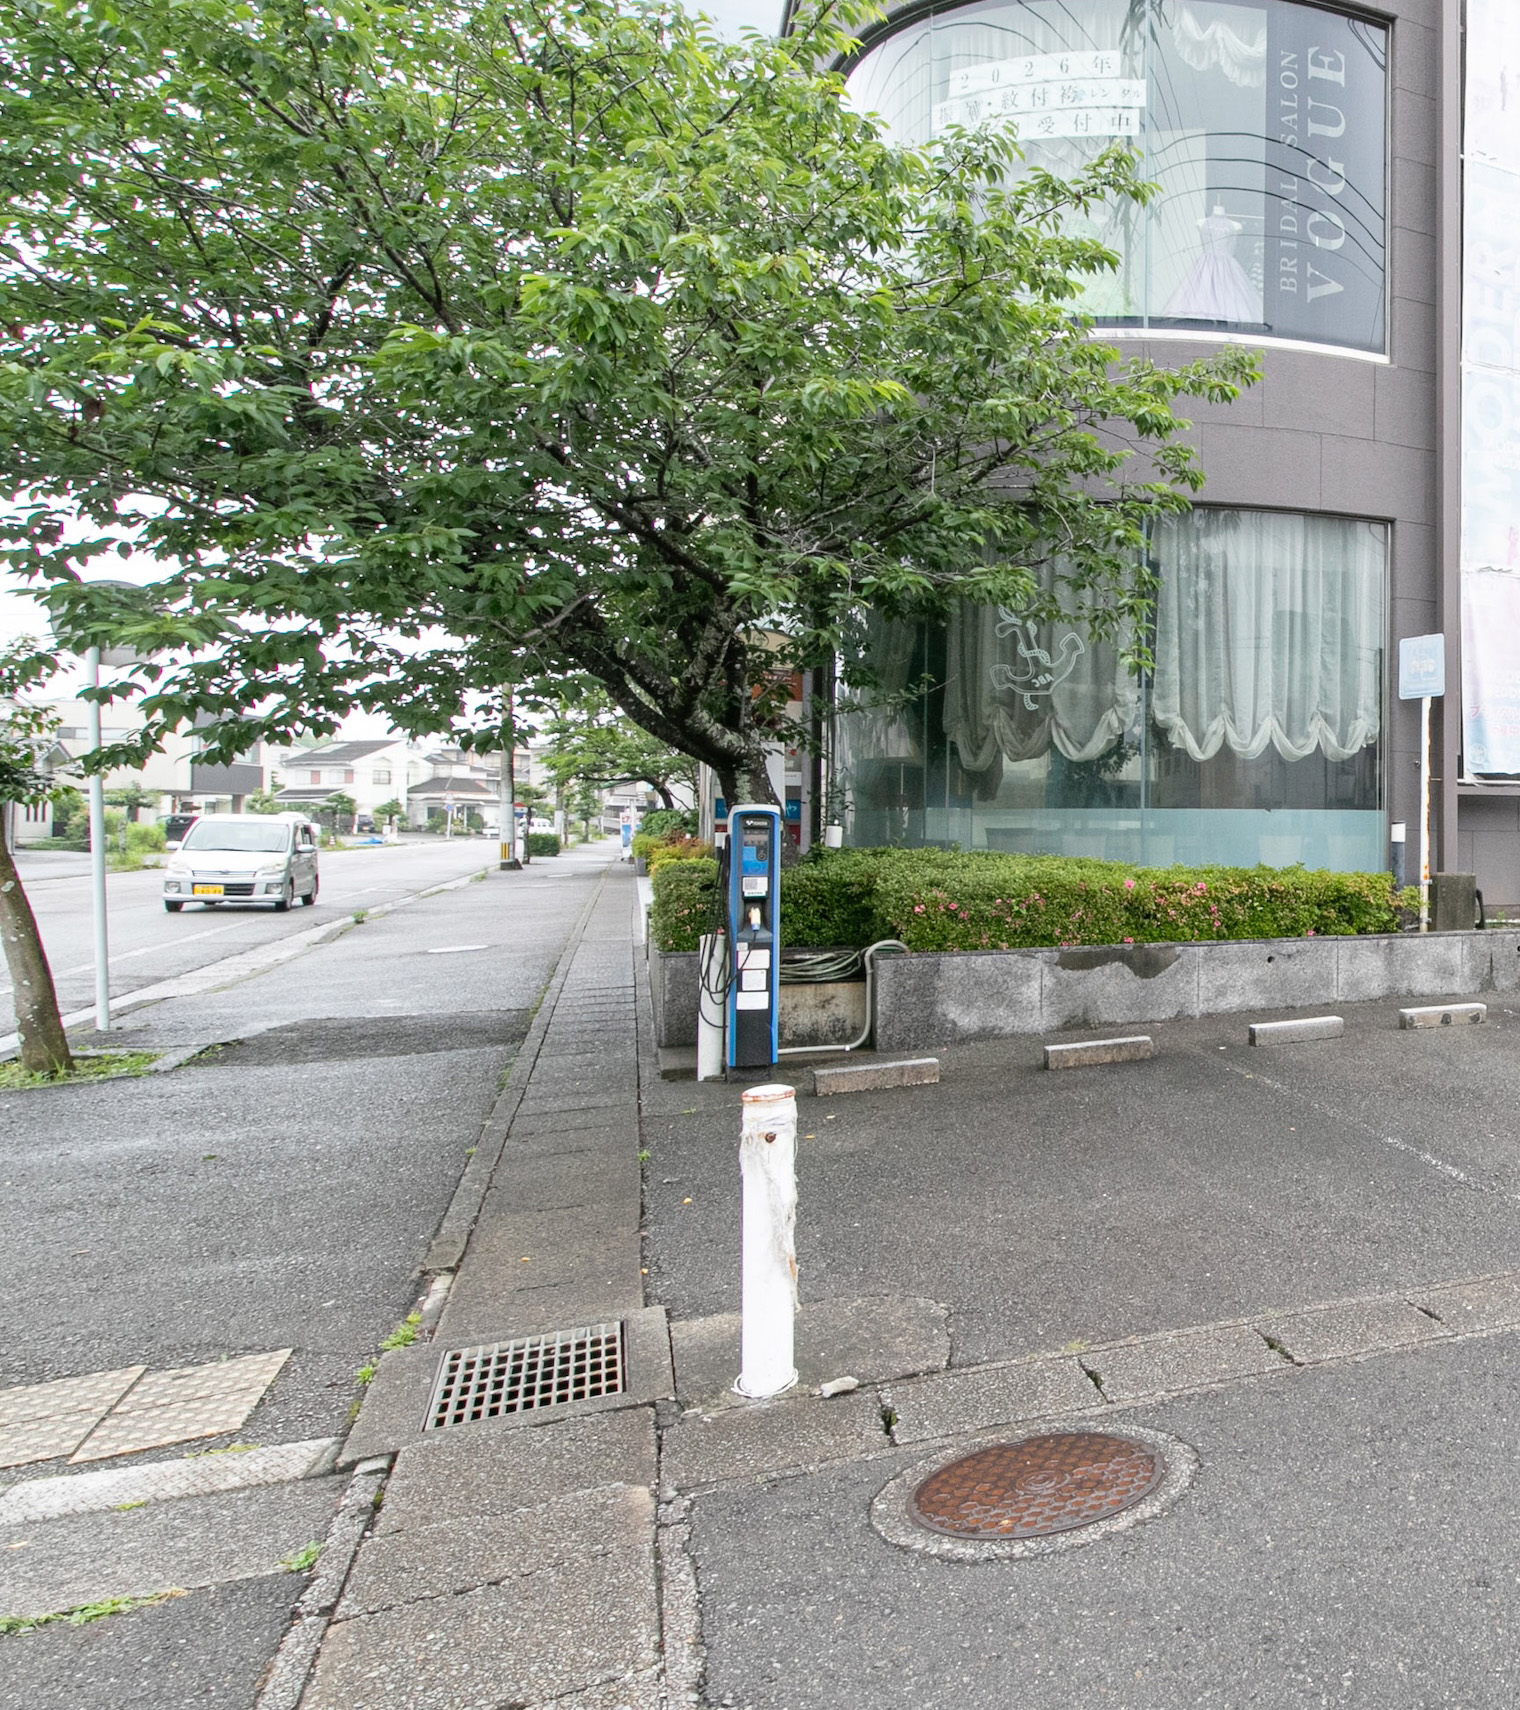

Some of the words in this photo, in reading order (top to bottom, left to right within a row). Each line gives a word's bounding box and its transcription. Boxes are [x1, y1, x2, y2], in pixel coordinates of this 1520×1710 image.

[960, 55, 1112, 89] 2026年
[1280, 50, 1298, 146] SALON
[1306, 47, 1346, 303] VOGUE
[1280, 177, 1298, 293] BRIDAL
